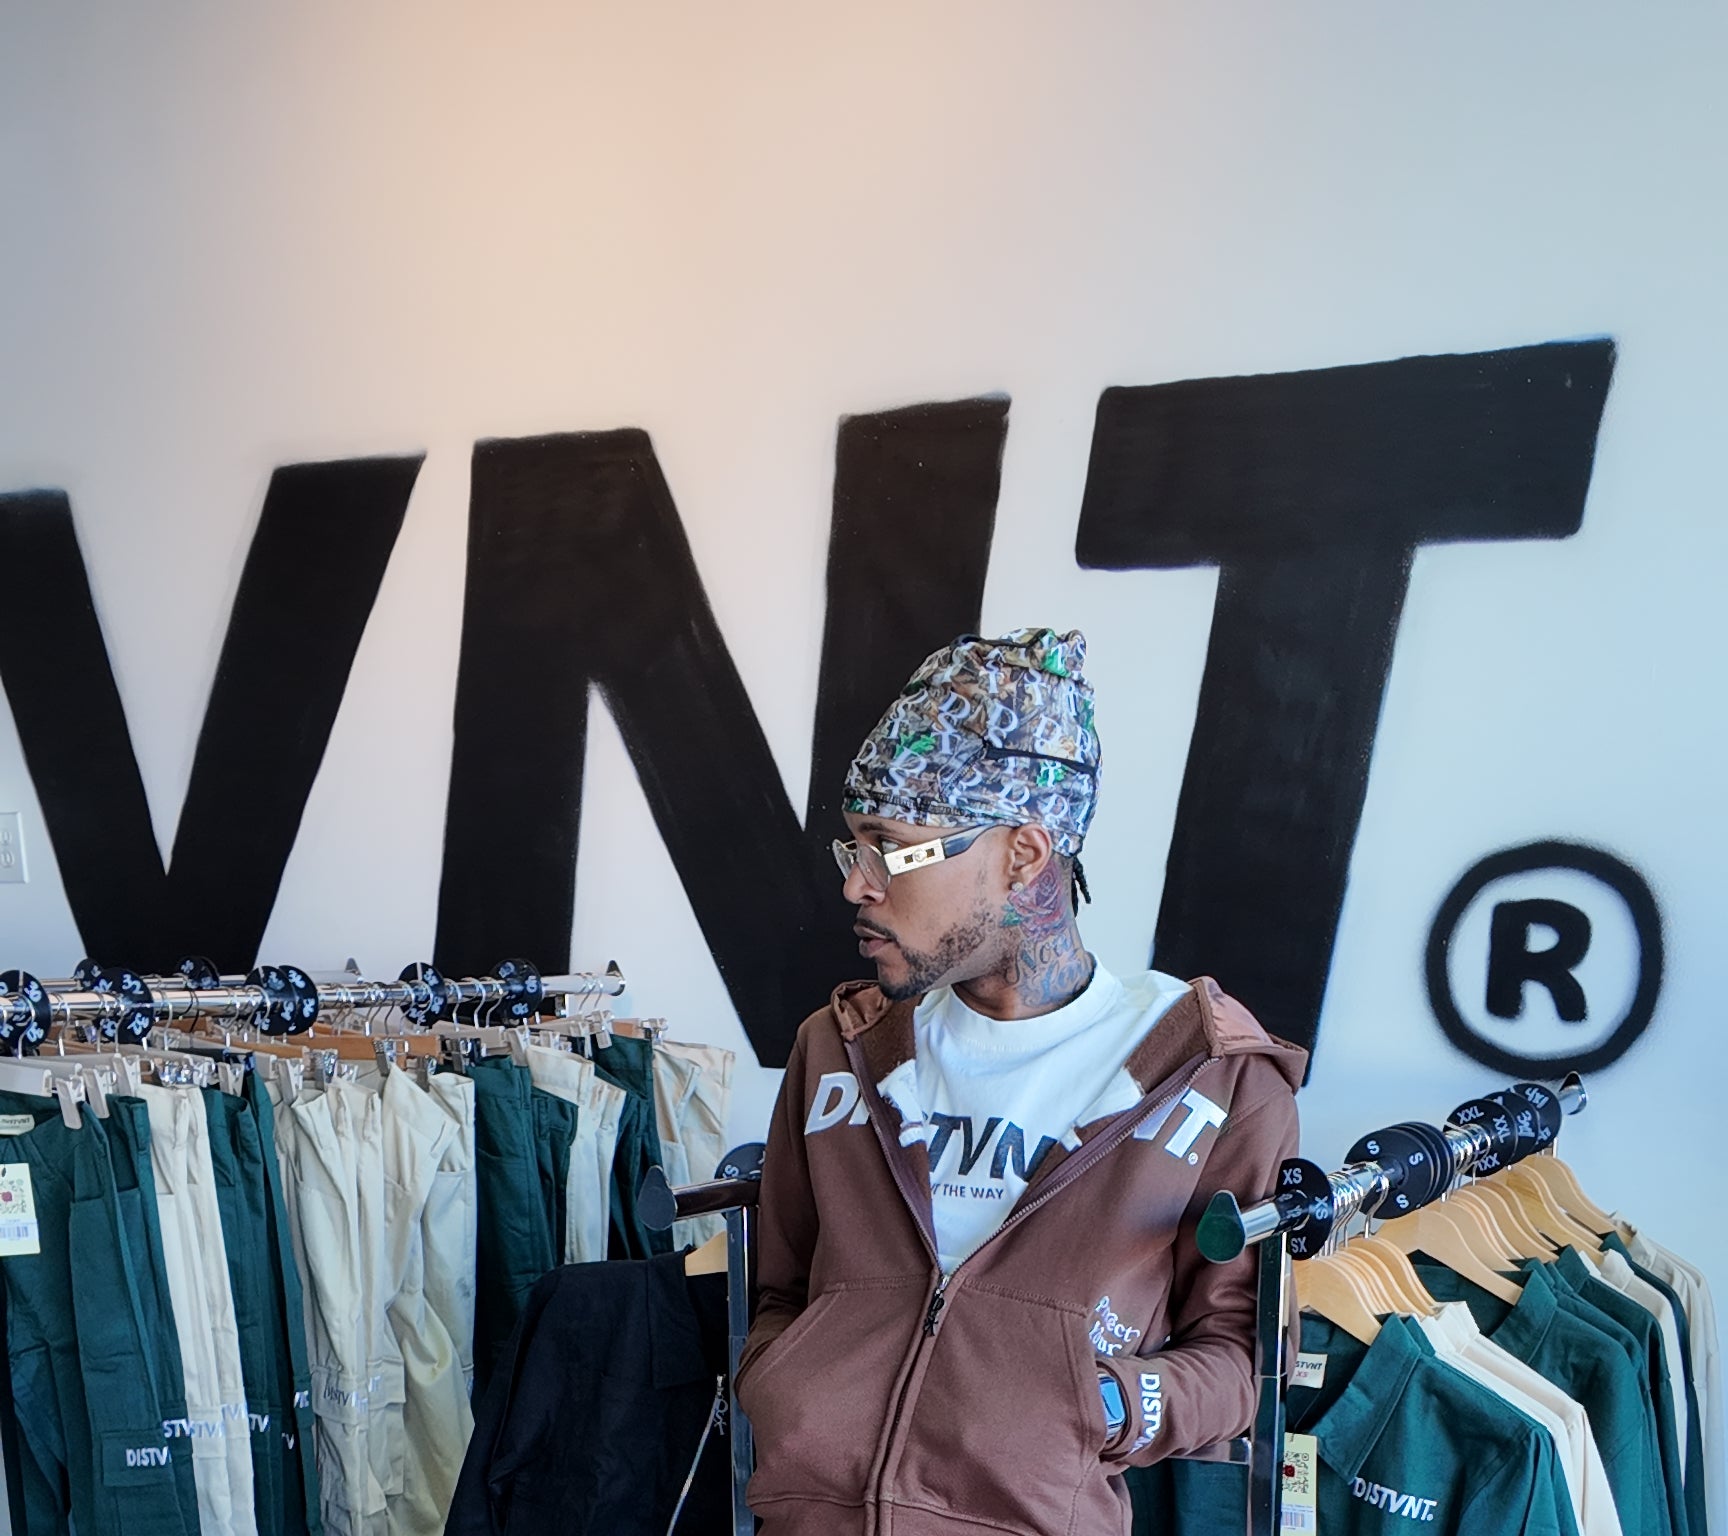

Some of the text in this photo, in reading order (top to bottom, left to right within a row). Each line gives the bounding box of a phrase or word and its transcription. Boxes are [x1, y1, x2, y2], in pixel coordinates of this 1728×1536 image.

[121, 972, 145, 995] 32
[1456, 1105, 1485, 1125] XXL
[1493, 1114, 1512, 1144] XXL
[1367, 1140, 1380, 1155] S
[1409, 1152, 1424, 1166] S
[1282, 1167, 1303, 1186] XS
[943, 1183, 966, 1198] THE
[970, 1186, 1004, 1200] WAY
[1396, 1194, 1410, 1209] S
[1315, 1195, 1329, 1220] XS
[126, 1446, 171, 1467] DISTV
[1351, 1476, 1438, 1522] DISTVNT.
